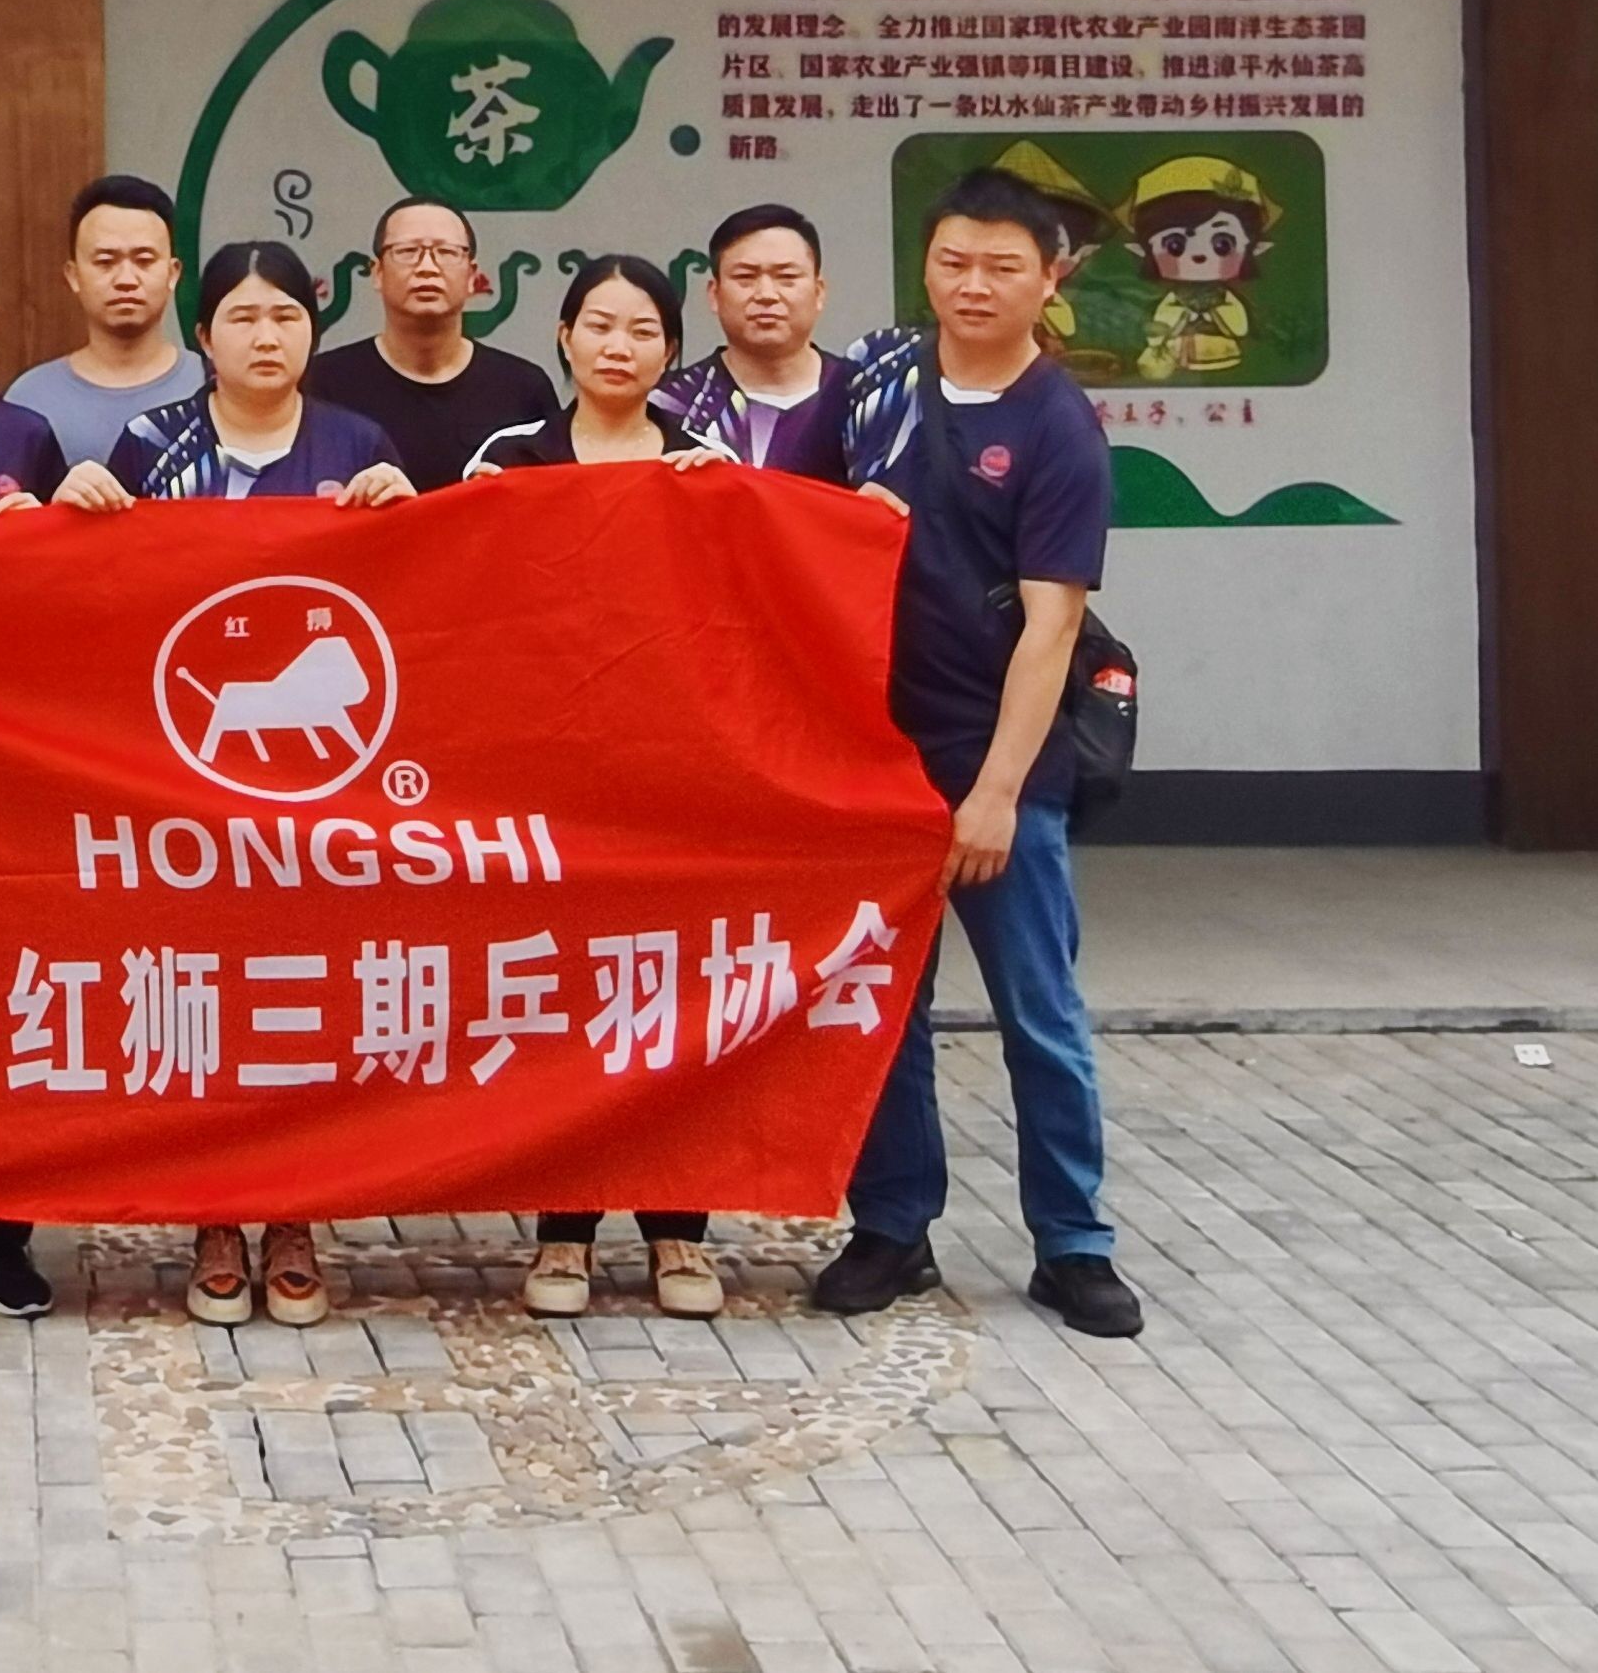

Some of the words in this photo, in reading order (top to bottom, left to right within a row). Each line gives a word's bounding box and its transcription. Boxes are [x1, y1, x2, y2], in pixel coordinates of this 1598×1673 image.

[446, 54, 541, 167] 茶
[223, 606, 333, 640] 红狮
[72, 811, 564, 891] HONGSHI
